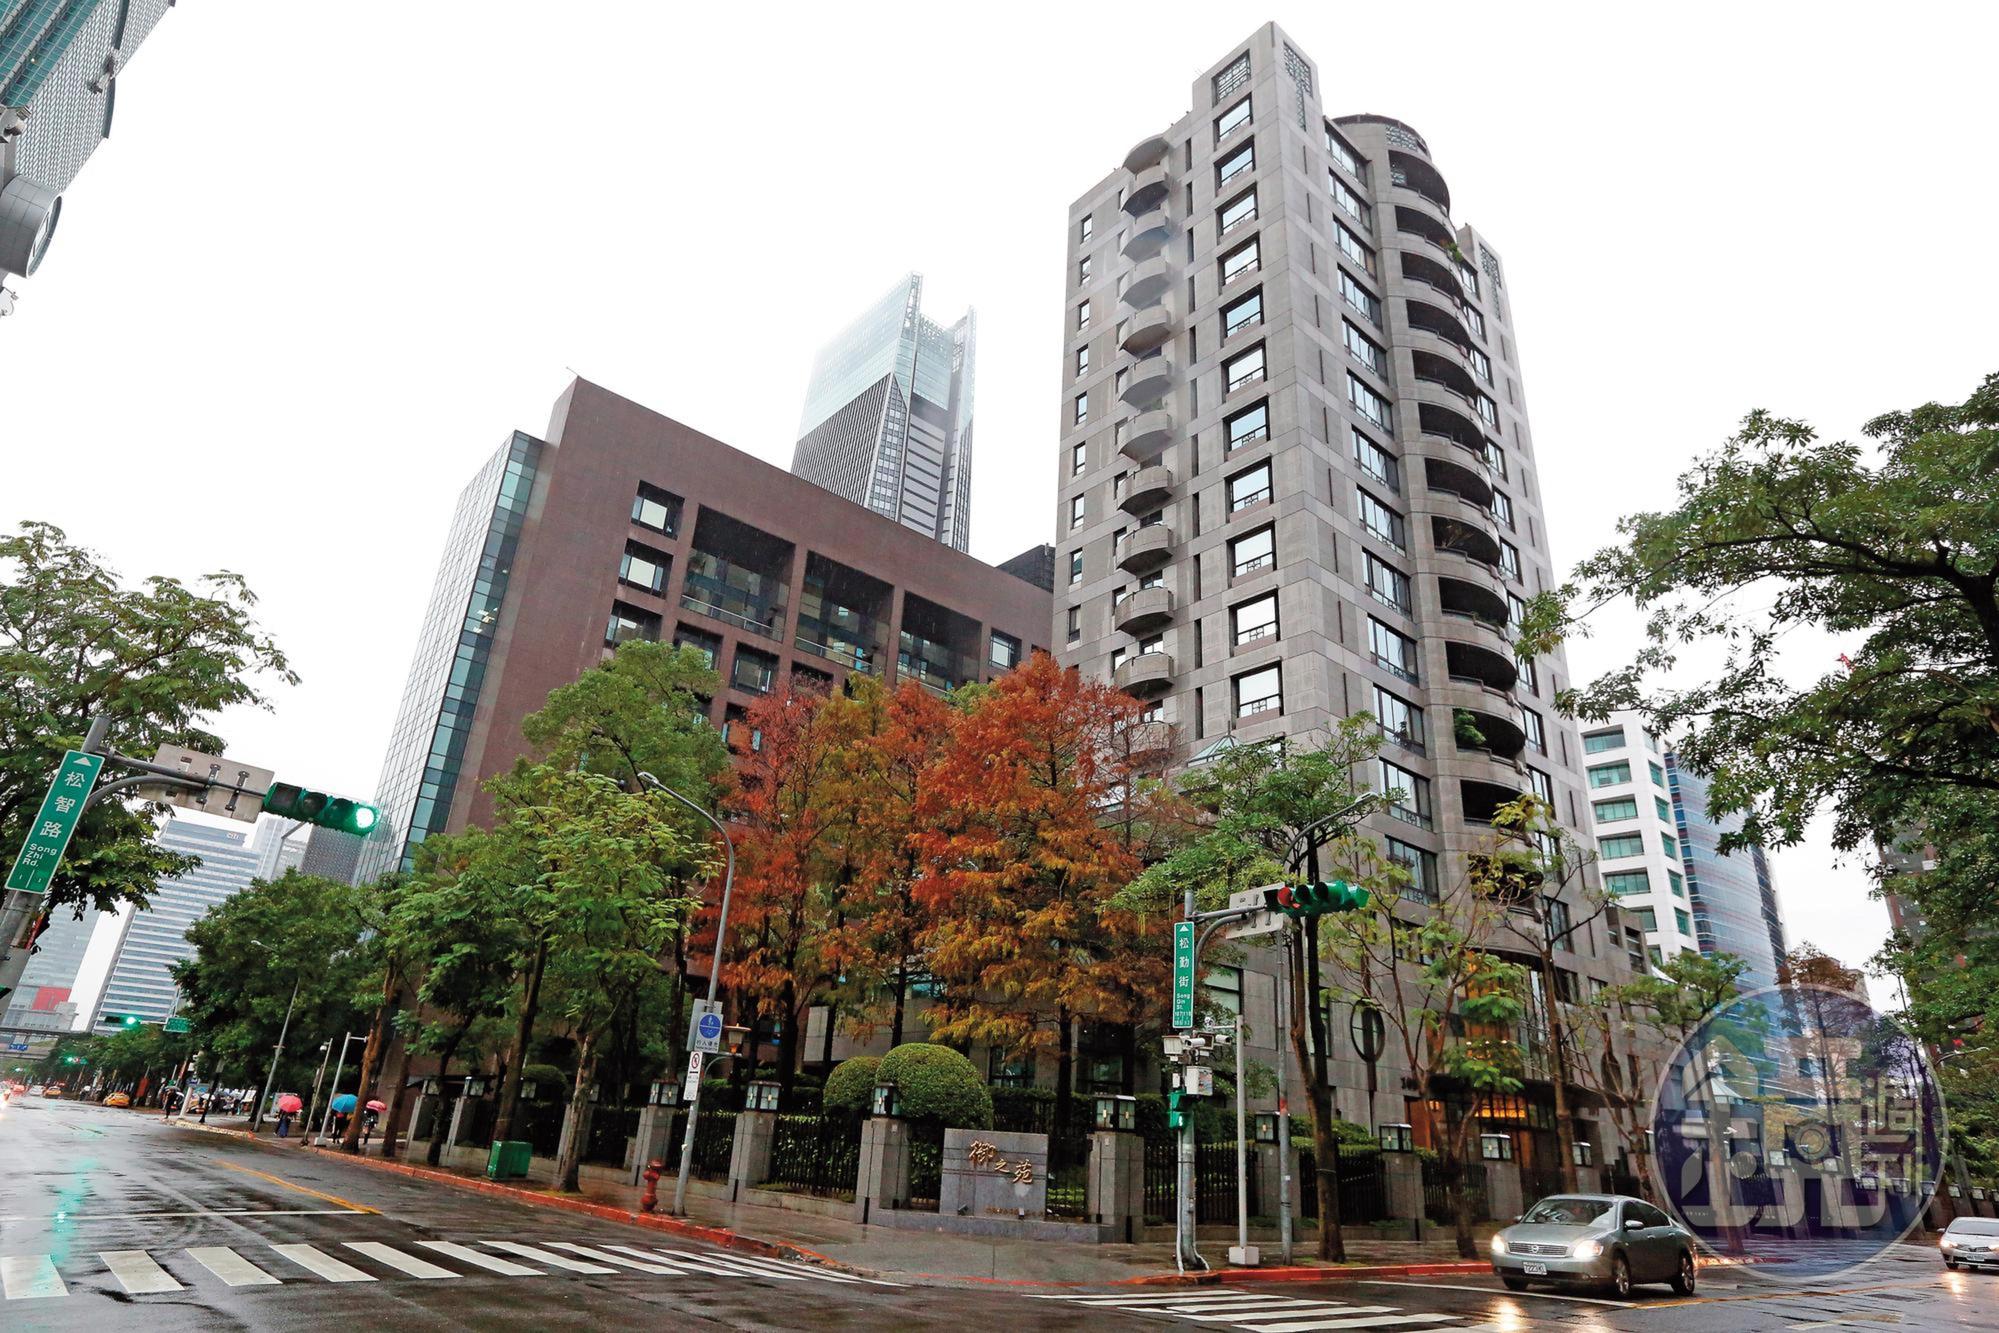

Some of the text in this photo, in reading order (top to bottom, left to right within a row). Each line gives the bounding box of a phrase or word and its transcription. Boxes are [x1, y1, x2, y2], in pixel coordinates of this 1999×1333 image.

[40, 771, 85, 839] 松智路
[25, 850, 43, 860] Zhi
[29, 843, 58, 856] Song
[1179, 938, 1190, 988] 松勤街
[968, 1139, 1034, 1186] 御之苑
